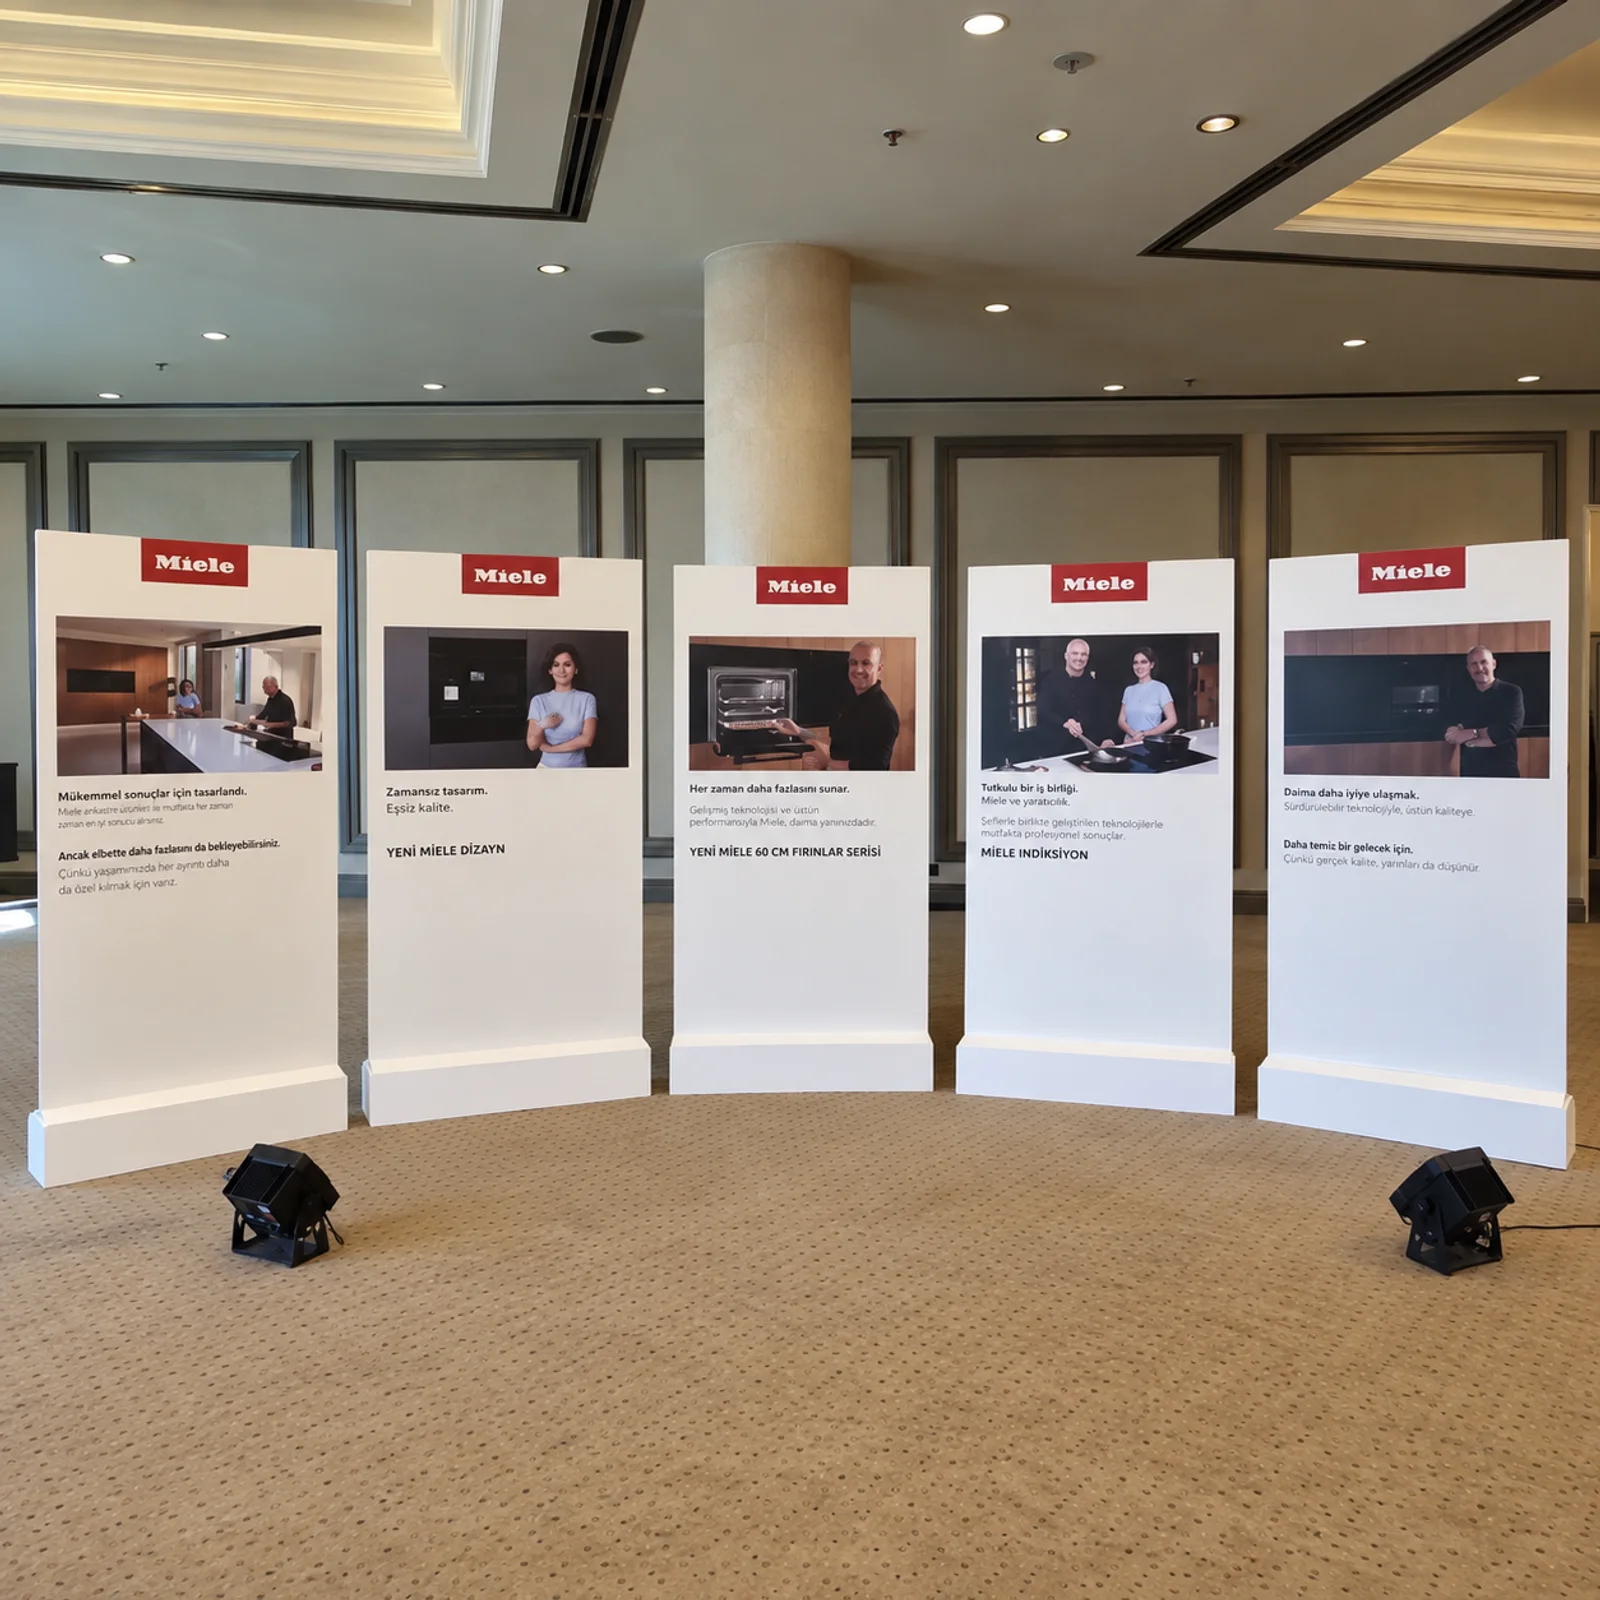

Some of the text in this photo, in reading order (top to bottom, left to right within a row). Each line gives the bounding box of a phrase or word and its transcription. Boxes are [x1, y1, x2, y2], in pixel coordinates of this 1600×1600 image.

[155, 554, 235, 574] Miele
[474, 568, 547, 585] Miele
[1371, 563, 1452, 581] Miele
[768, 579, 837, 594] Miele
[1063, 576, 1135, 591] Miele
[58, 786, 248, 802] Mükemmel sonuçlar için tasarlandı.
[386, 787, 488, 797] Zamansız tasarım.
[689, 783, 850, 794] Her zaman daha fazlasını sunar.
[981, 783, 1079, 795] Tutkulu bir iş birliği.
[1284, 787, 1420, 801] Daima daha iyiye ulaşmak.
[981, 796, 1007, 805] Miele
[1009, 798, 1021, 806] ve
[386, 802, 454, 817] Eşsiz kalite.
[1405, 805, 1433, 816] üstün
[1083, 831, 1126, 842] sonuçlar.
[58, 838, 281, 861] Ancak elbette daha fazlasını da bekleyebilirsiniz.
[386, 842, 506, 858] YENİ MİELE DİZAYN
[689, 845, 881, 857] YENİ MİELE 60 CM FIRINLAR SERİSİ
[981, 845, 1016, 858] MİELE
[1283, 840, 1414, 856] Daha temiz bir gelecek için.
[58, 868, 92, 881] Çünkü
[158, 861, 175, 872] her
[206, 858, 230, 868] daha
[1316, 856, 1349, 867] gerçek
[1422, 861, 1435, 870] da
[58, 886, 72, 896] da
[74, 884, 96, 895] özel
[98, 881, 131, 892] kılmak
[133, 880, 151, 891] için
